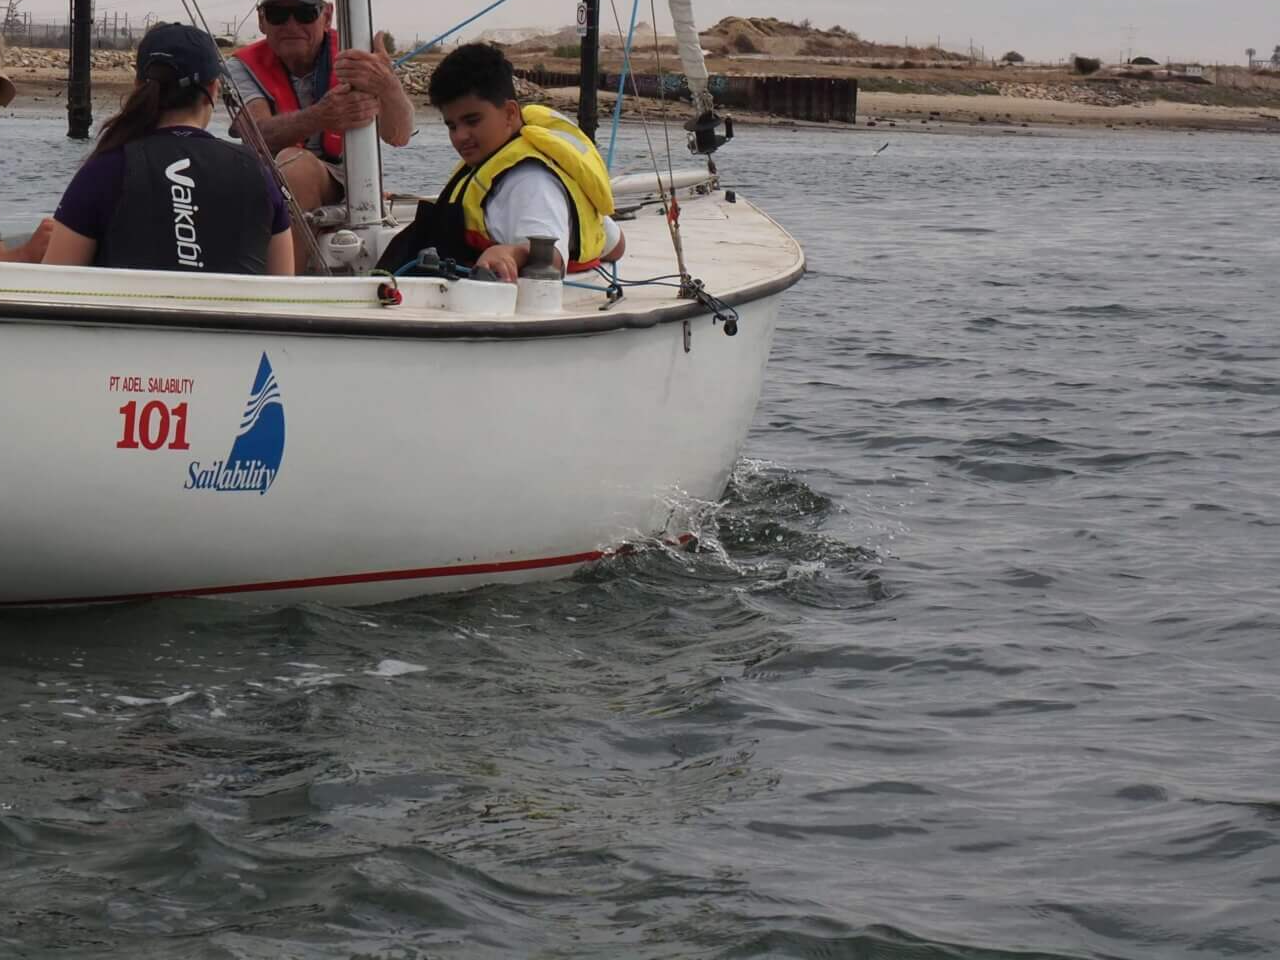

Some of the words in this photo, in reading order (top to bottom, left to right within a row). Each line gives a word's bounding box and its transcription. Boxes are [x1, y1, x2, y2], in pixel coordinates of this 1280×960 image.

[165, 158, 204, 268] Vaikobi
[109, 376, 120, 392] PT
[148, 378, 194, 394] SAILABILITY
[116, 400, 190, 451] 101
[184, 460, 275, 495] Sailability
